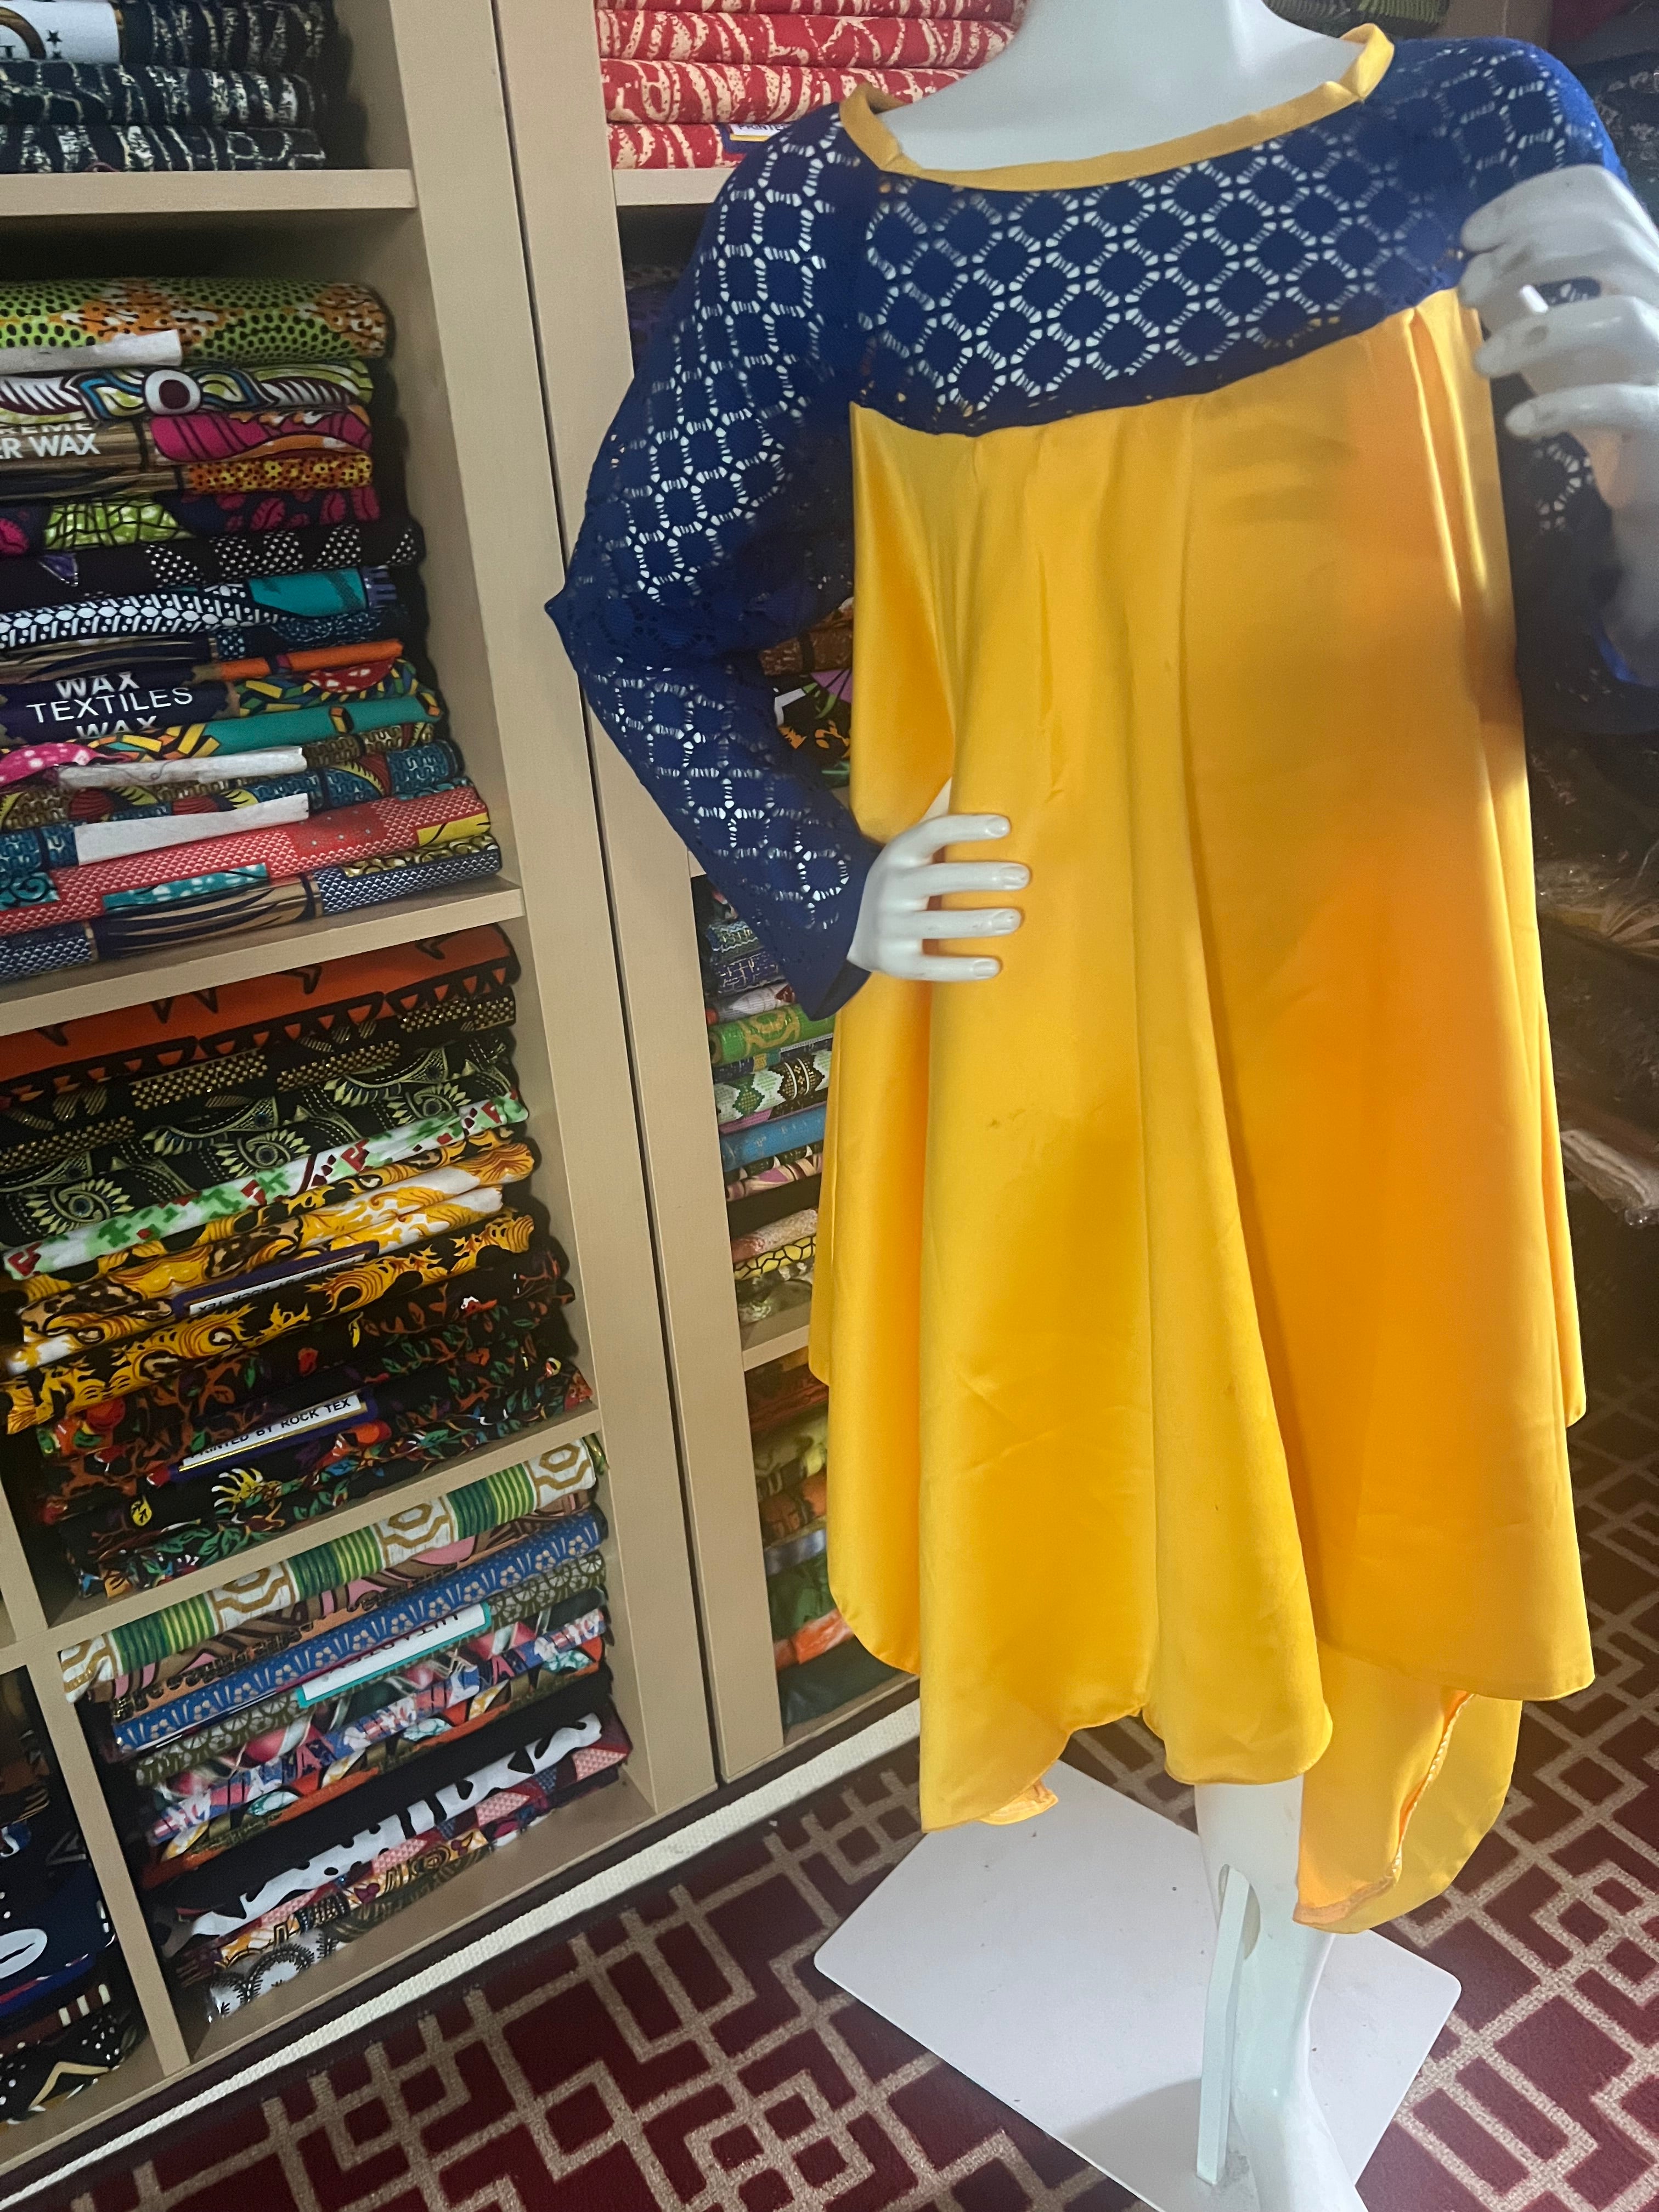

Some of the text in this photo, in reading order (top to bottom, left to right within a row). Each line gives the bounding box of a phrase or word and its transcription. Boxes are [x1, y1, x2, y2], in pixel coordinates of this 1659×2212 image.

[0, 433, 101, 459] R WAX
[56, 671, 140, 699] WAX
[26, 687, 193, 723] TEXTILES
[76, 715, 157, 738] WAX
[281, 1409, 319, 1428] ROCK
[324, 1398, 351, 1413] TEX
